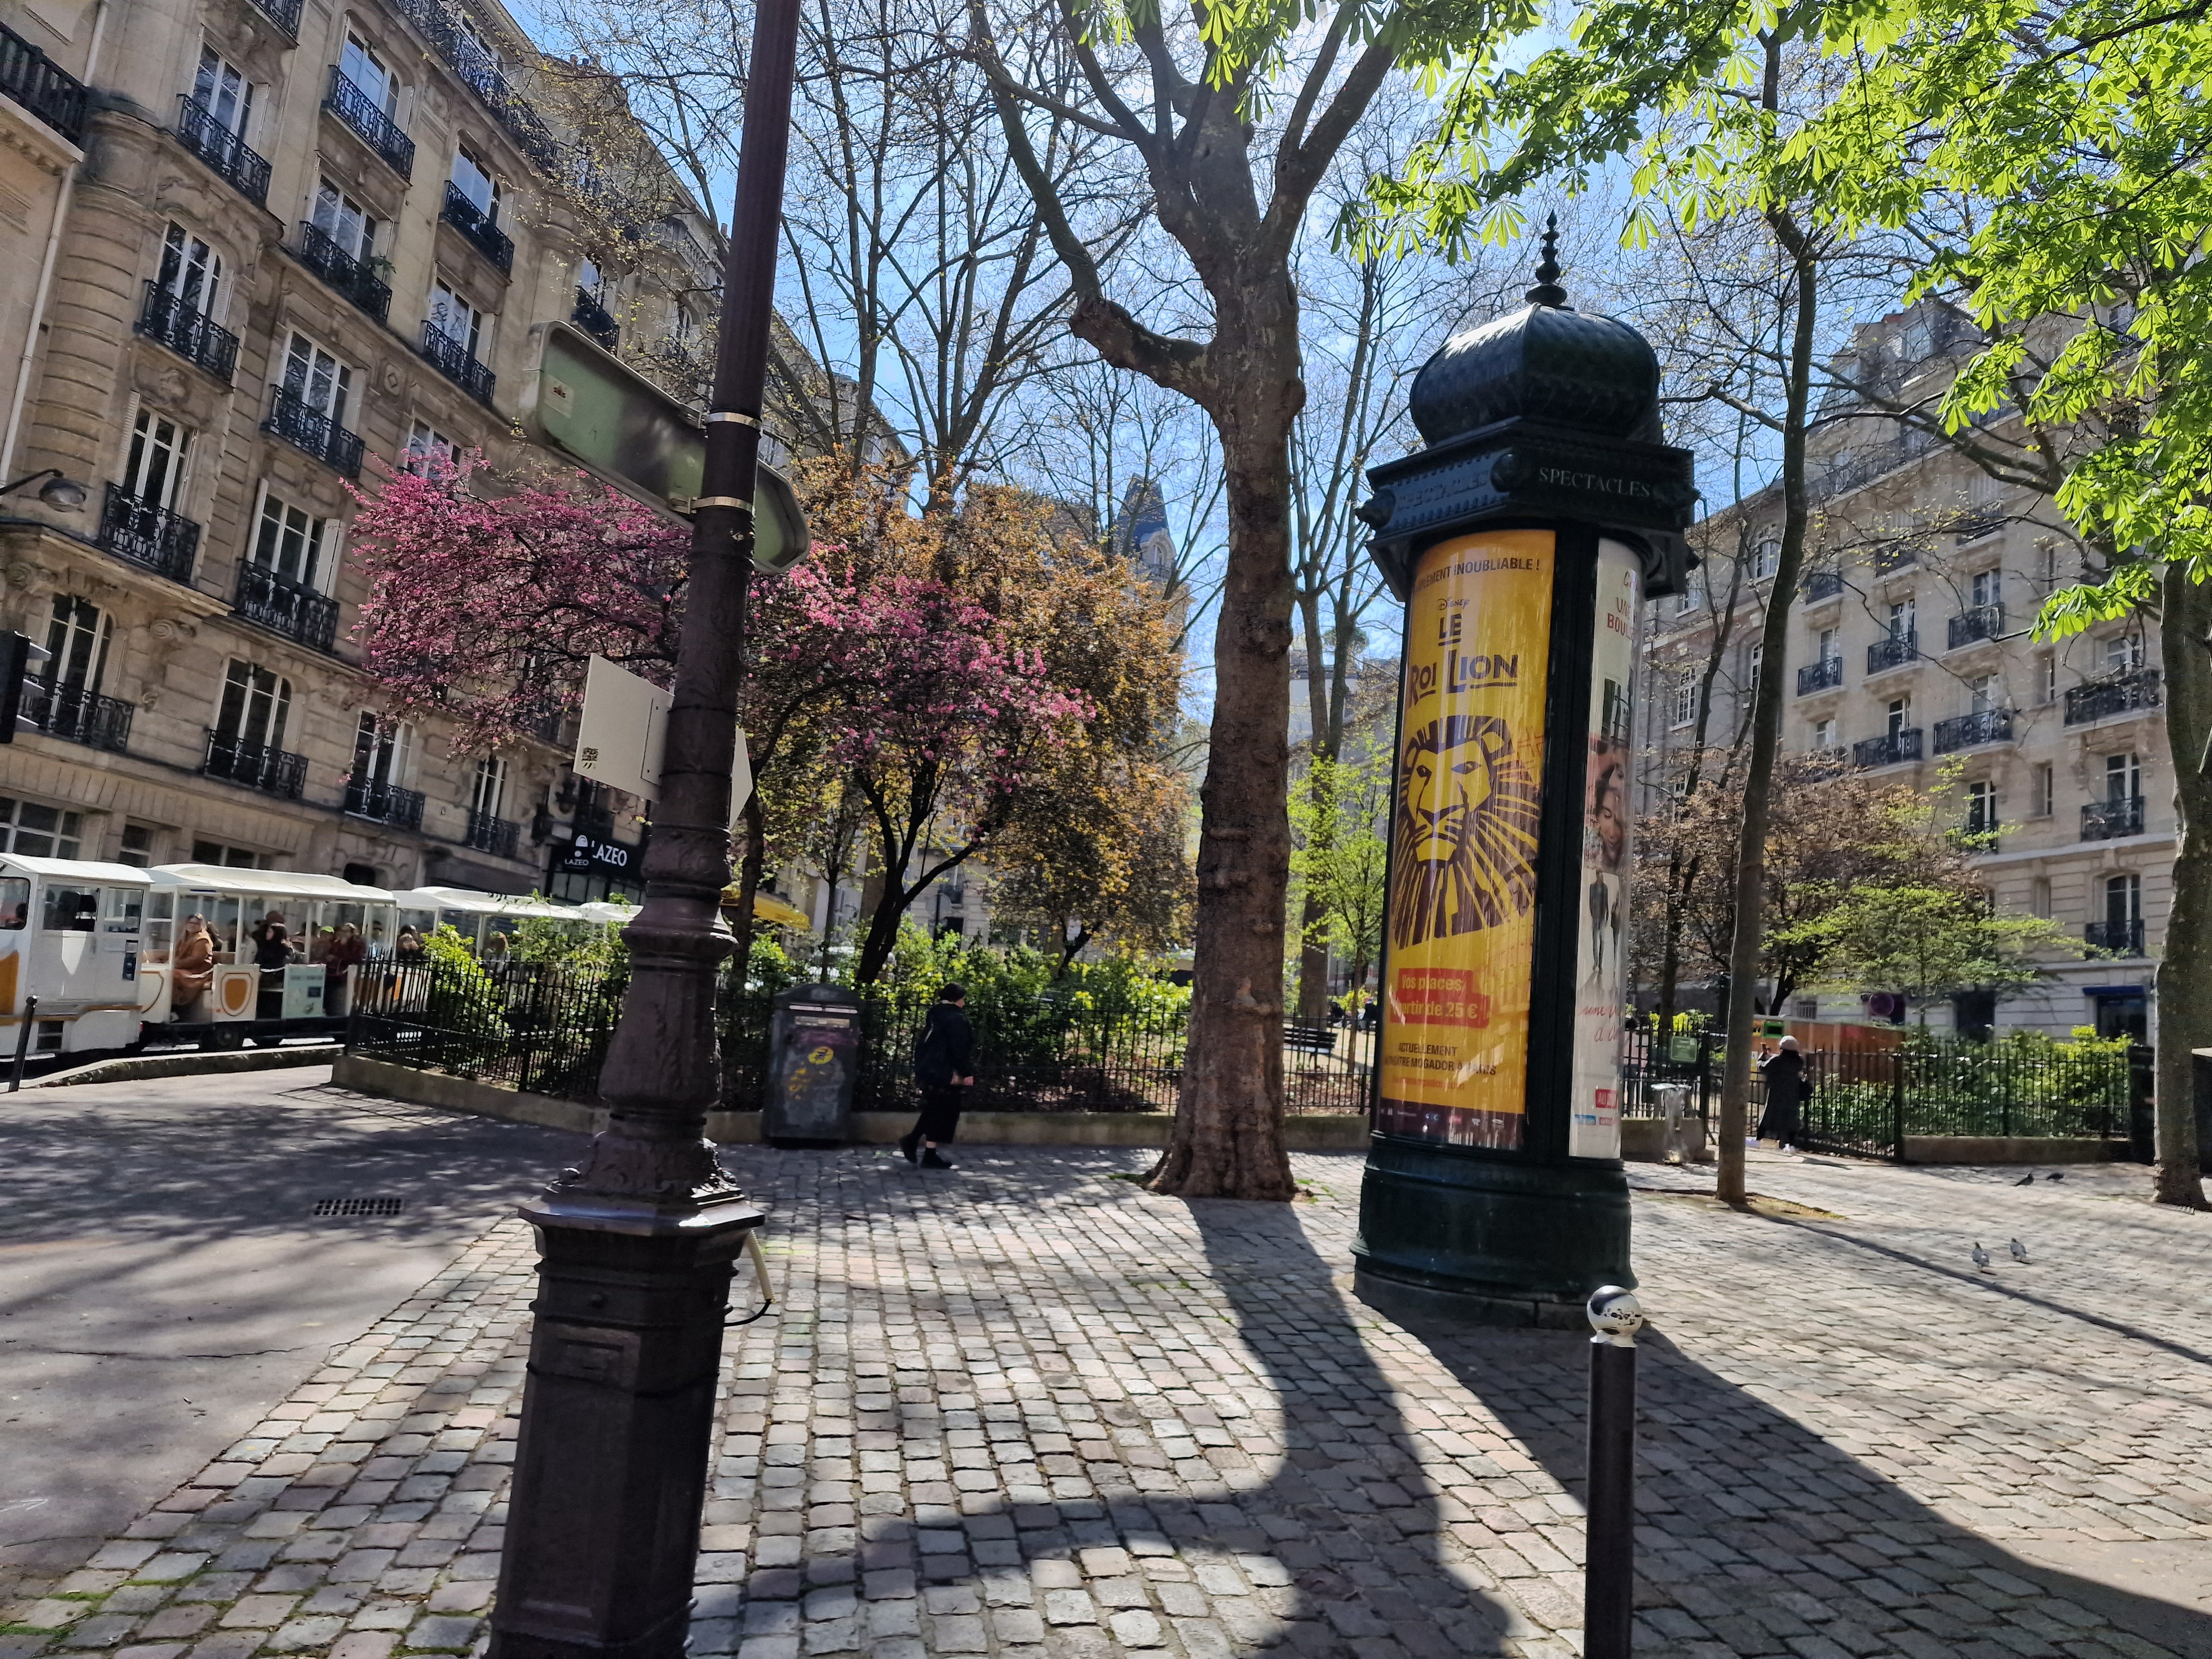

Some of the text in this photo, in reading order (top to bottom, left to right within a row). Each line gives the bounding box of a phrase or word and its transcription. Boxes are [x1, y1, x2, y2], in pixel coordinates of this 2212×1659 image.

[1540, 467, 1650, 497] SPECTACLES
[1439, 613, 1462, 639] LE
[1409, 649, 1519, 707] ROI LION
[1419, 977, 1462, 991] paces
[1397, 1000, 1425, 1016] artir
[1446, 1001, 1464, 1018] 25
[1399, 1042, 1458, 1057] ACTUELLEMENT
[1411, 1058, 1454, 1072] MOGADOR
